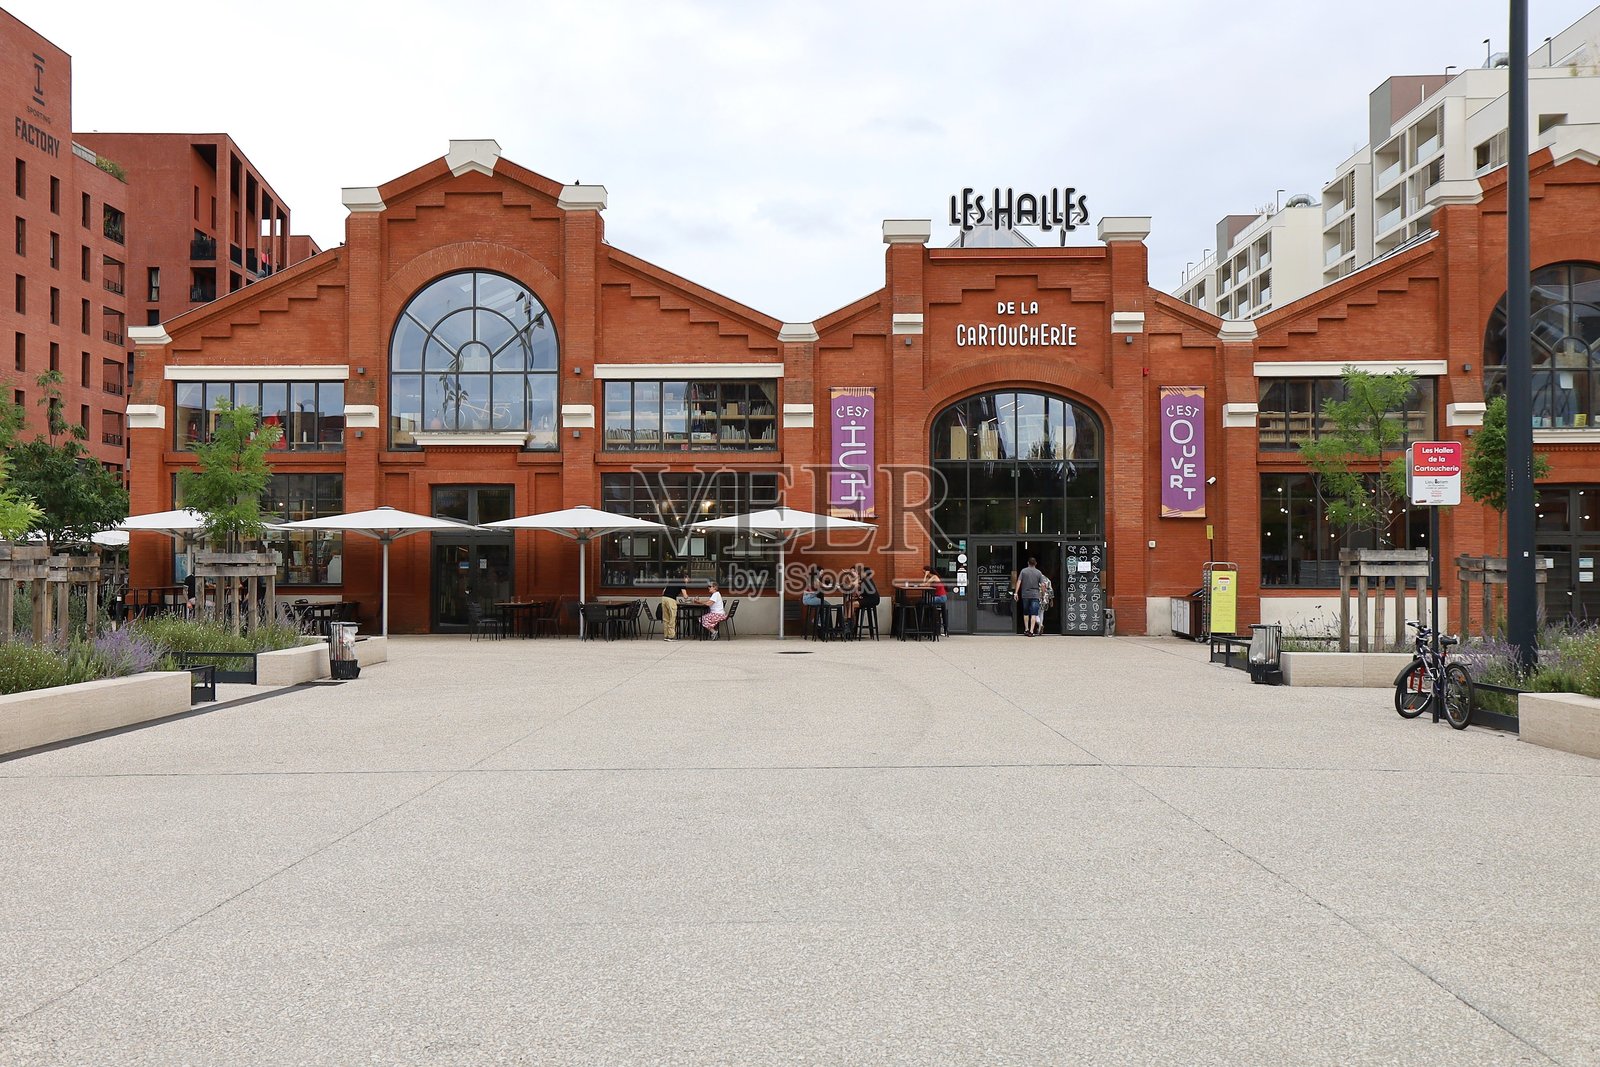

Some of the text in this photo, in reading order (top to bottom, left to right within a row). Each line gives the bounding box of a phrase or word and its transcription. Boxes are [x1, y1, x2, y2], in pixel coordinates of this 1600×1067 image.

[15, 116, 60, 159] FACTORY
[950, 187, 1089, 231] LES HALLES
[997, 301, 1039, 315] DE LA
[956, 323, 1077, 347] CARTOUCHERIE
[836, 405, 869, 418] C'EST
[1166, 405, 1199, 418] C'EST
[1169, 419, 1197, 500] OUVERT
